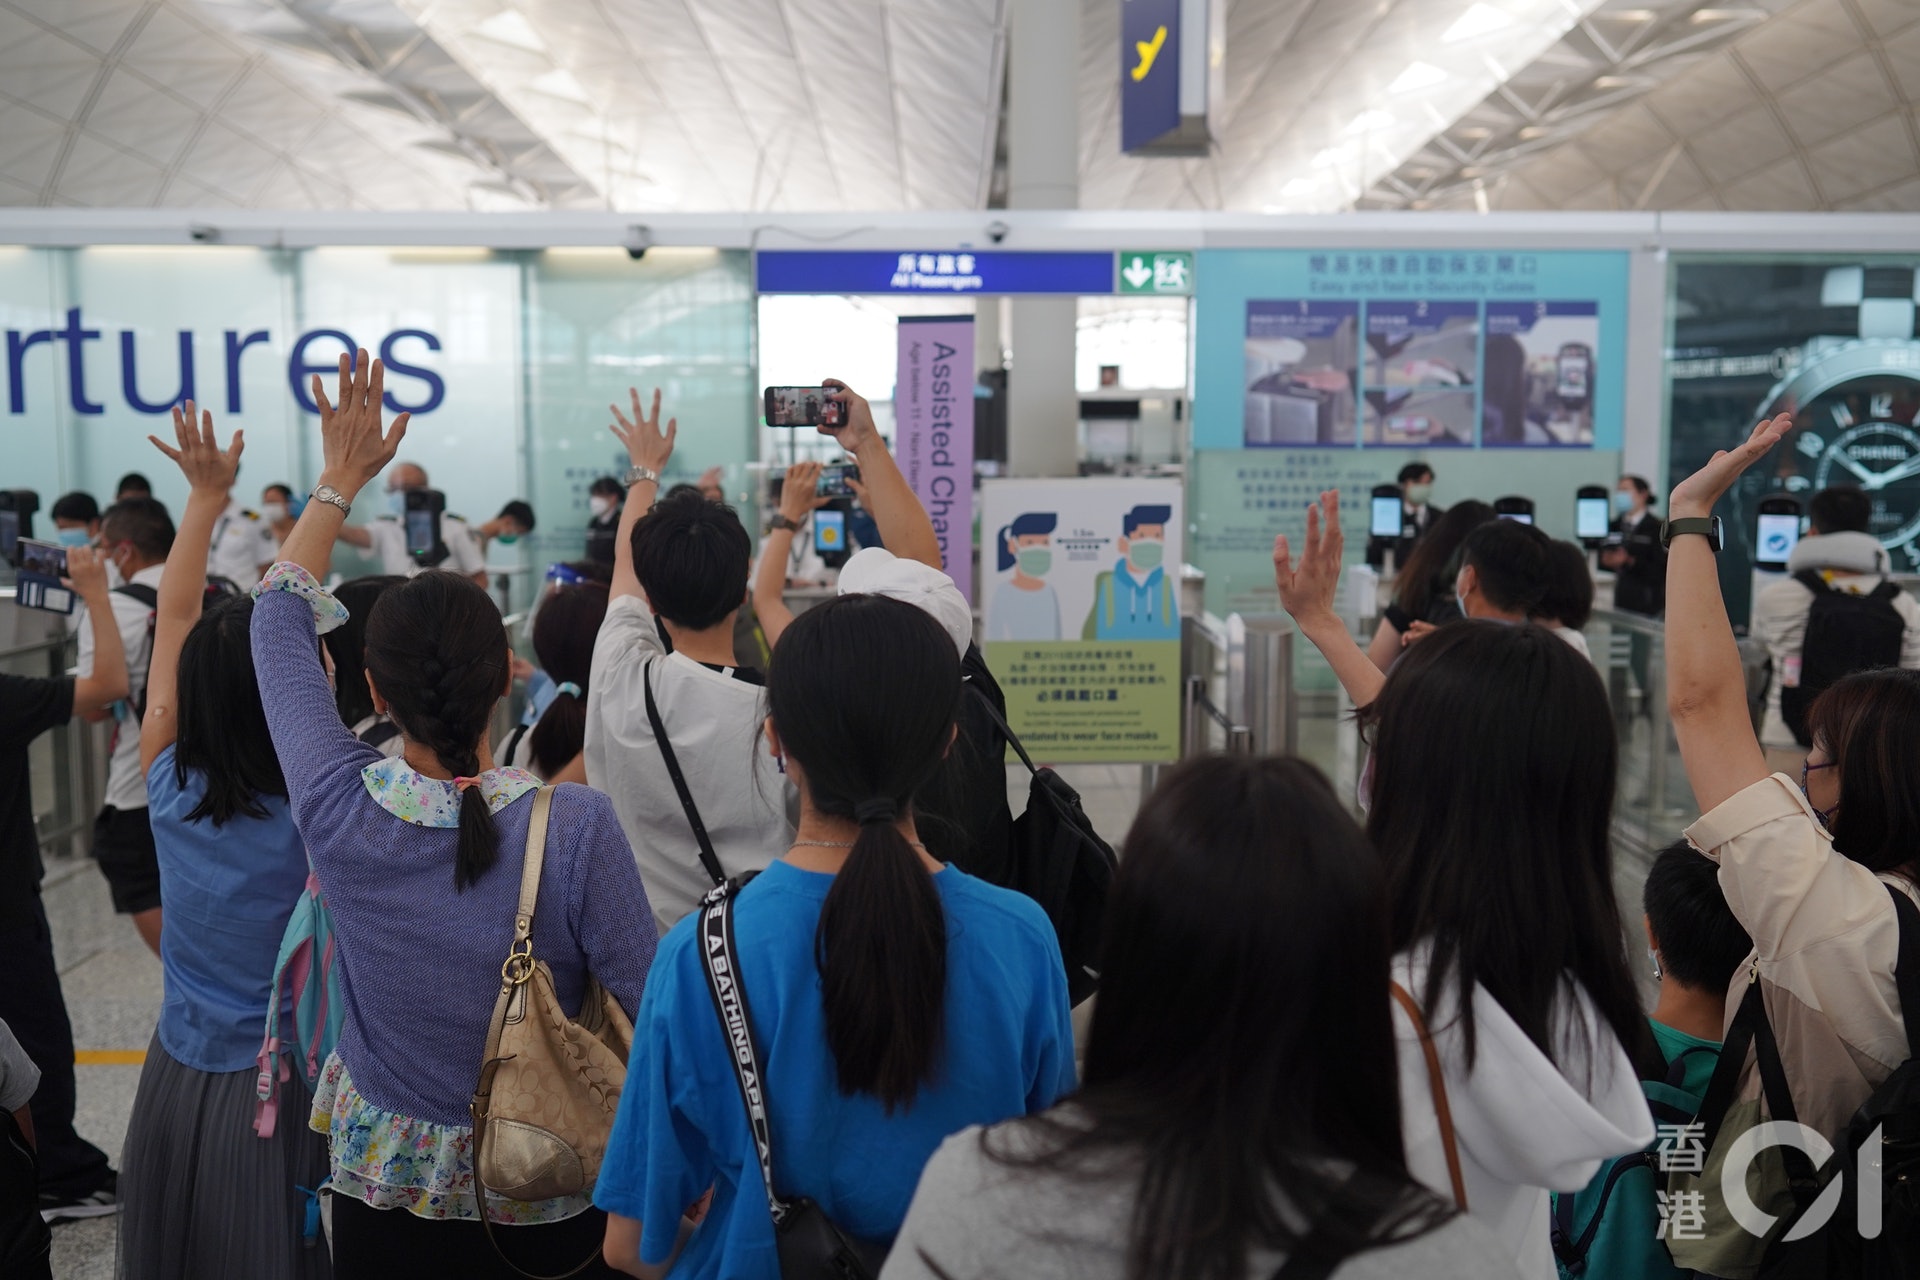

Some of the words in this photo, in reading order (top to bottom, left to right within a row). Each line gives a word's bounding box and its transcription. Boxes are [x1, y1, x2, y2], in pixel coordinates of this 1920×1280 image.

[890, 272, 910, 288] All
[911, 272, 983, 291] Passengers
[931, 341, 957, 467] Assisted
[1847, 444, 1908, 461] CHANEL
[708, 934, 723, 954] A
[712, 955, 751, 1065] BATHING
[743, 1068, 764, 1121] APE
